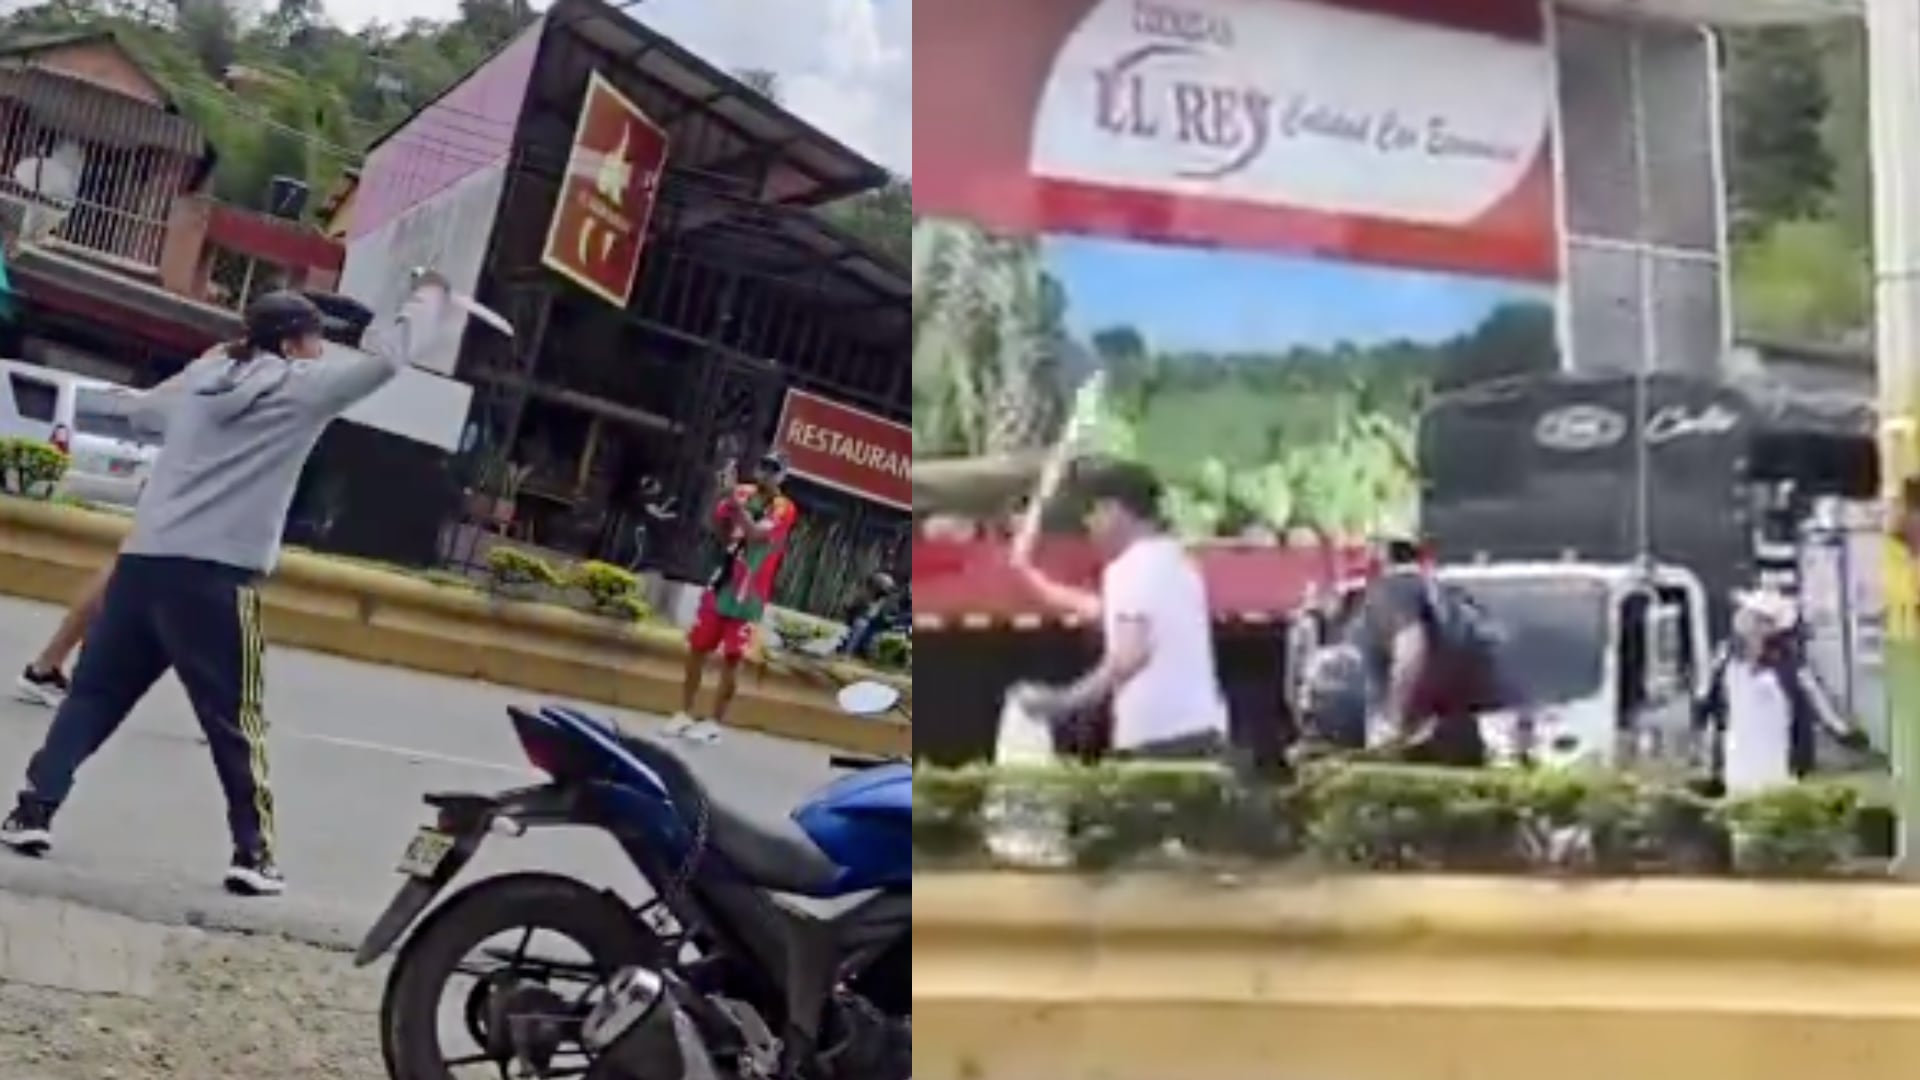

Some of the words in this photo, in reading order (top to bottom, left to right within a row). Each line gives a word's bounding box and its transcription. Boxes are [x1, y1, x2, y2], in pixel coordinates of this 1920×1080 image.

[1093, 68, 1158, 138] EL
[1173, 82, 1274, 172] REY
[787, 418, 912, 481] RESTAURAN
